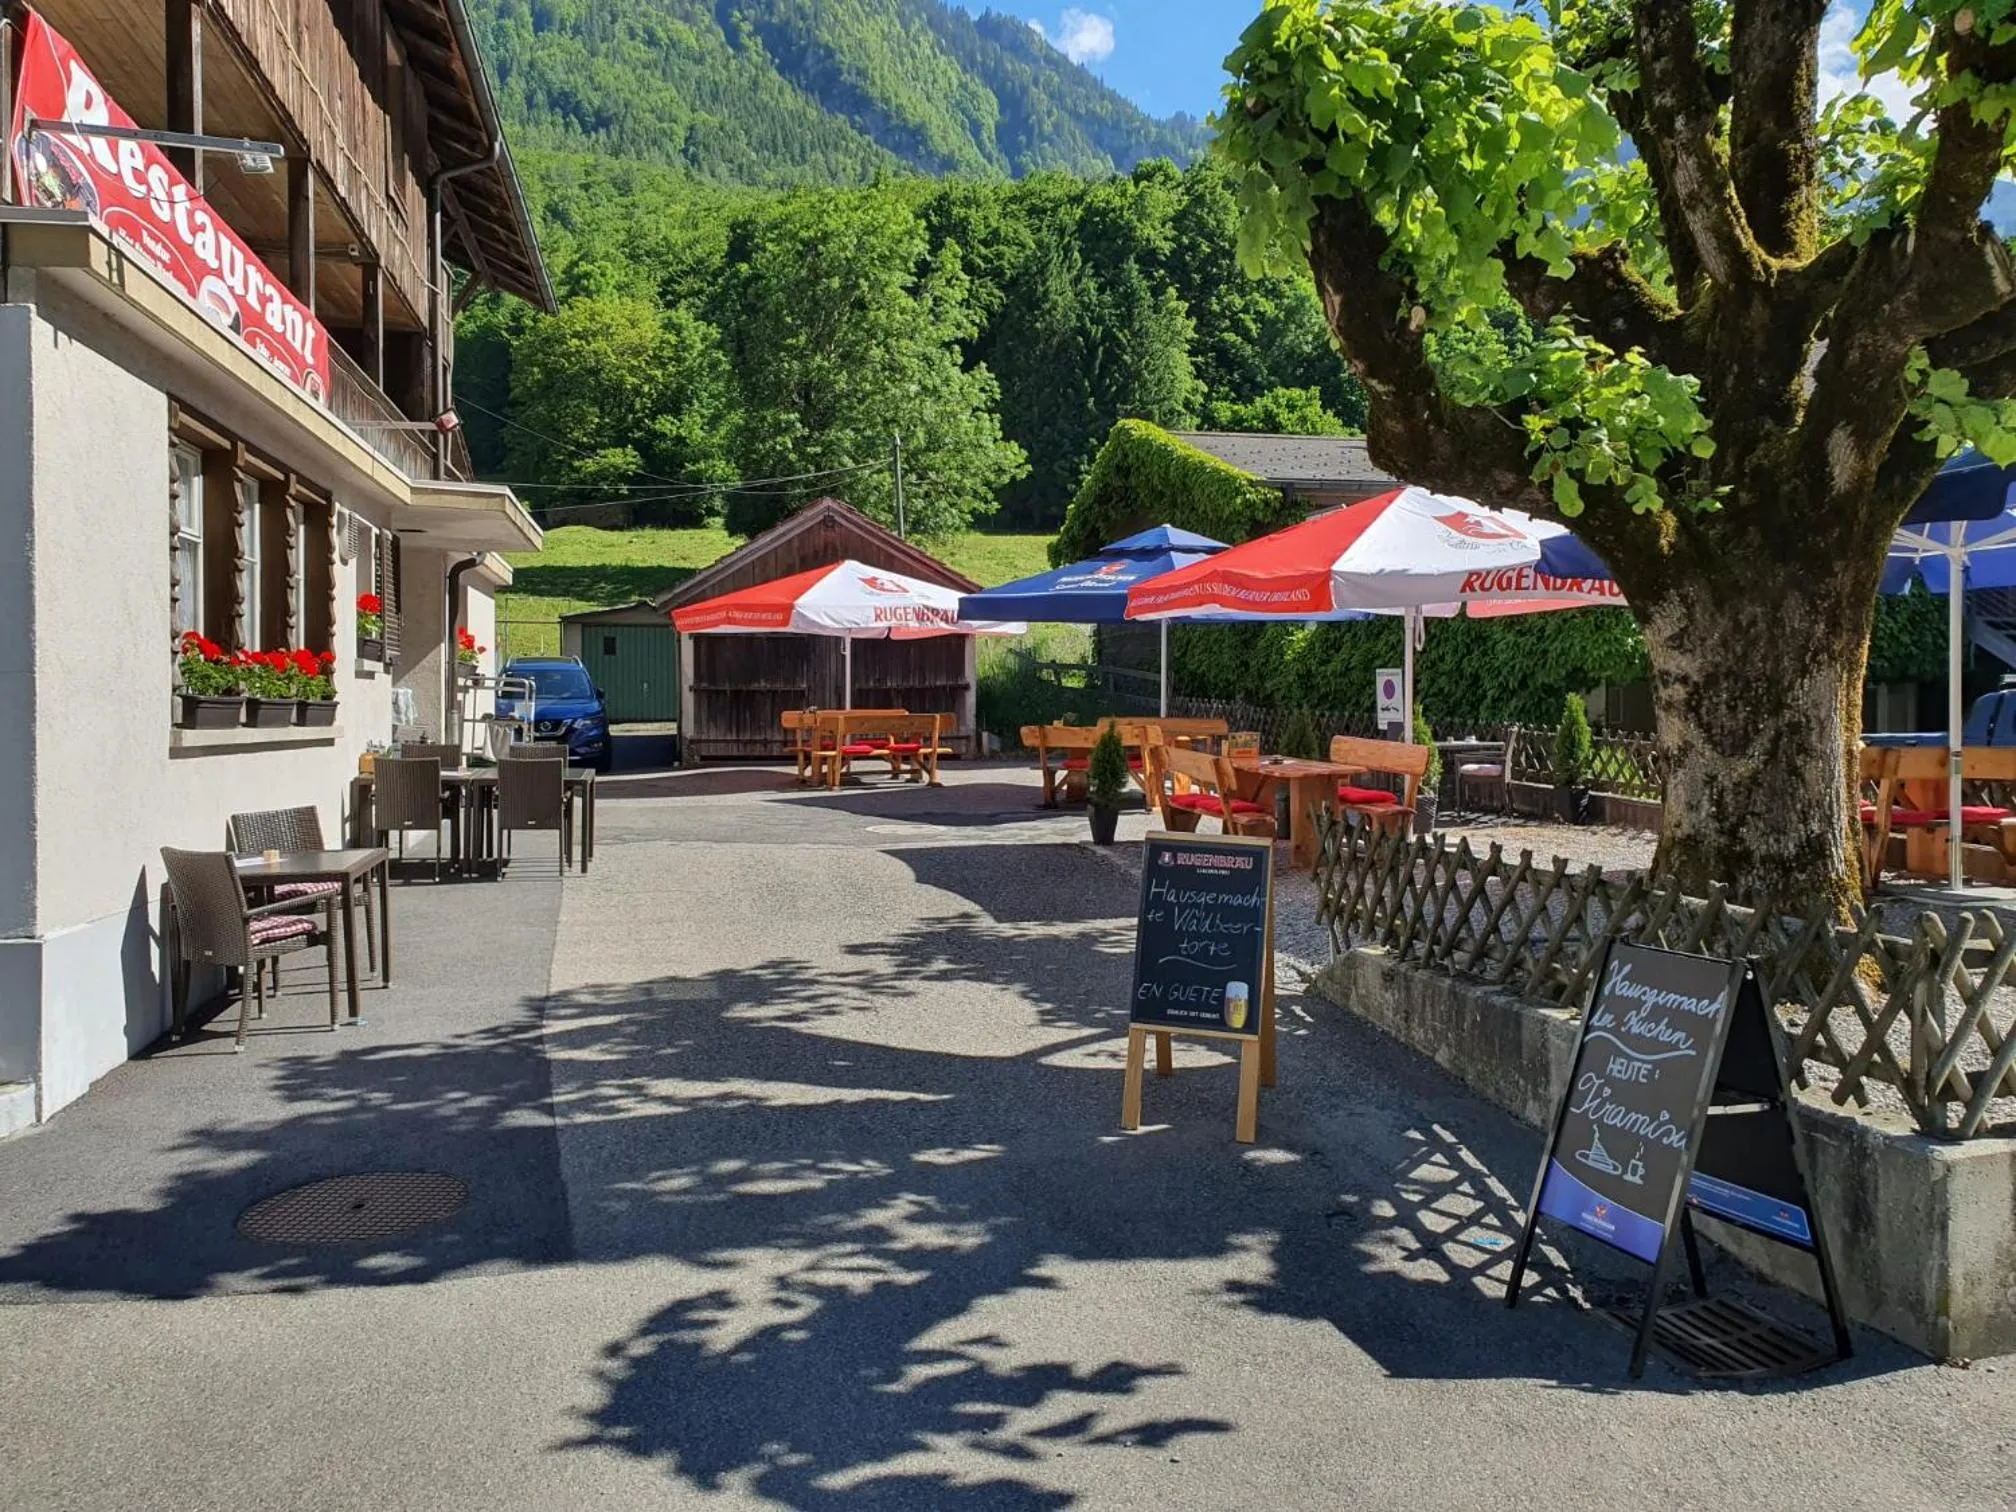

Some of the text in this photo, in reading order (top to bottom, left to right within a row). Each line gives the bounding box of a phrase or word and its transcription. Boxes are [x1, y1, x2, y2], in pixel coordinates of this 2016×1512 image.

[61, 58, 317, 365] Restaurant
[1178, 937, 1232, 956] torte
[1138, 982, 1224, 1005] EN GUETE
[1569, 1072, 1688, 1151] Tiramisu
